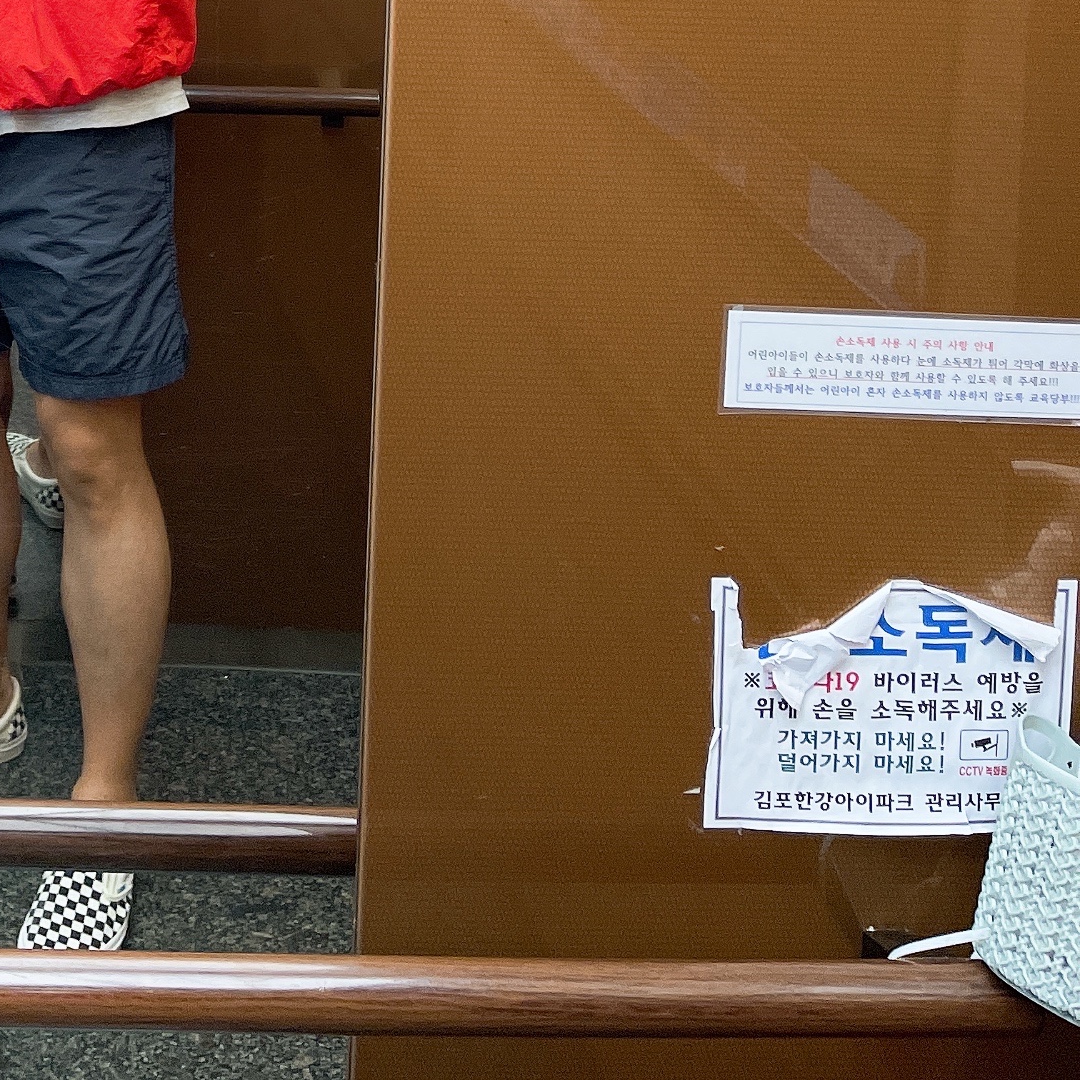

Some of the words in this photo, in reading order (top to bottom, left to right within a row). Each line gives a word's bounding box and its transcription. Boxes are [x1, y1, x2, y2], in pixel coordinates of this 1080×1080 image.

[836, 336, 876, 347] 손소독제
[881, 338, 902, 349] 사용
[906, 338, 917, 349] 시
[923, 339, 942, 350] 주의
[974, 341, 994, 352] 안내
[748, 350, 808, 362] 어린아이들이
[814, 352, 865, 364] 손소독제를
[871, 354, 911, 365] 사용하다
[916, 356, 937, 366] 눈에
[943, 357, 983, 368] 소독제가
[793, 367, 803, 378] 수
[808, 368, 838, 379] 있으니
[844, 370, 884, 381] 보호자와
[890, 371, 910, 382] 함께
[916, 372, 946, 384] 사용할
[951, 373, 961, 384] 수
[967, 374, 997, 385] 있도록
[743, 382, 815, 395] 보호자들께서는
[820, 385, 860, 397] 어린아이
[866, 386, 886, 398] 혼자
[892, 387, 942, 400] 손소독제를
[948, 390, 988, 401] 사용하지
[874, 671, 963, 693] 바이러스
[977, 671, 1044, 694] 예방을
[812, 699, 857, 720] 손을
[777, 729, 862, 751] 가져가지
[874, 731, 946, 752] 마세요!
[777, 752, 861, 774] 덜어가지
[874, 753, 945, 773] 마세요!
[959, 765, 983, 776] CCTV
[753, 790, 914, 813] 김포한강아이파크
